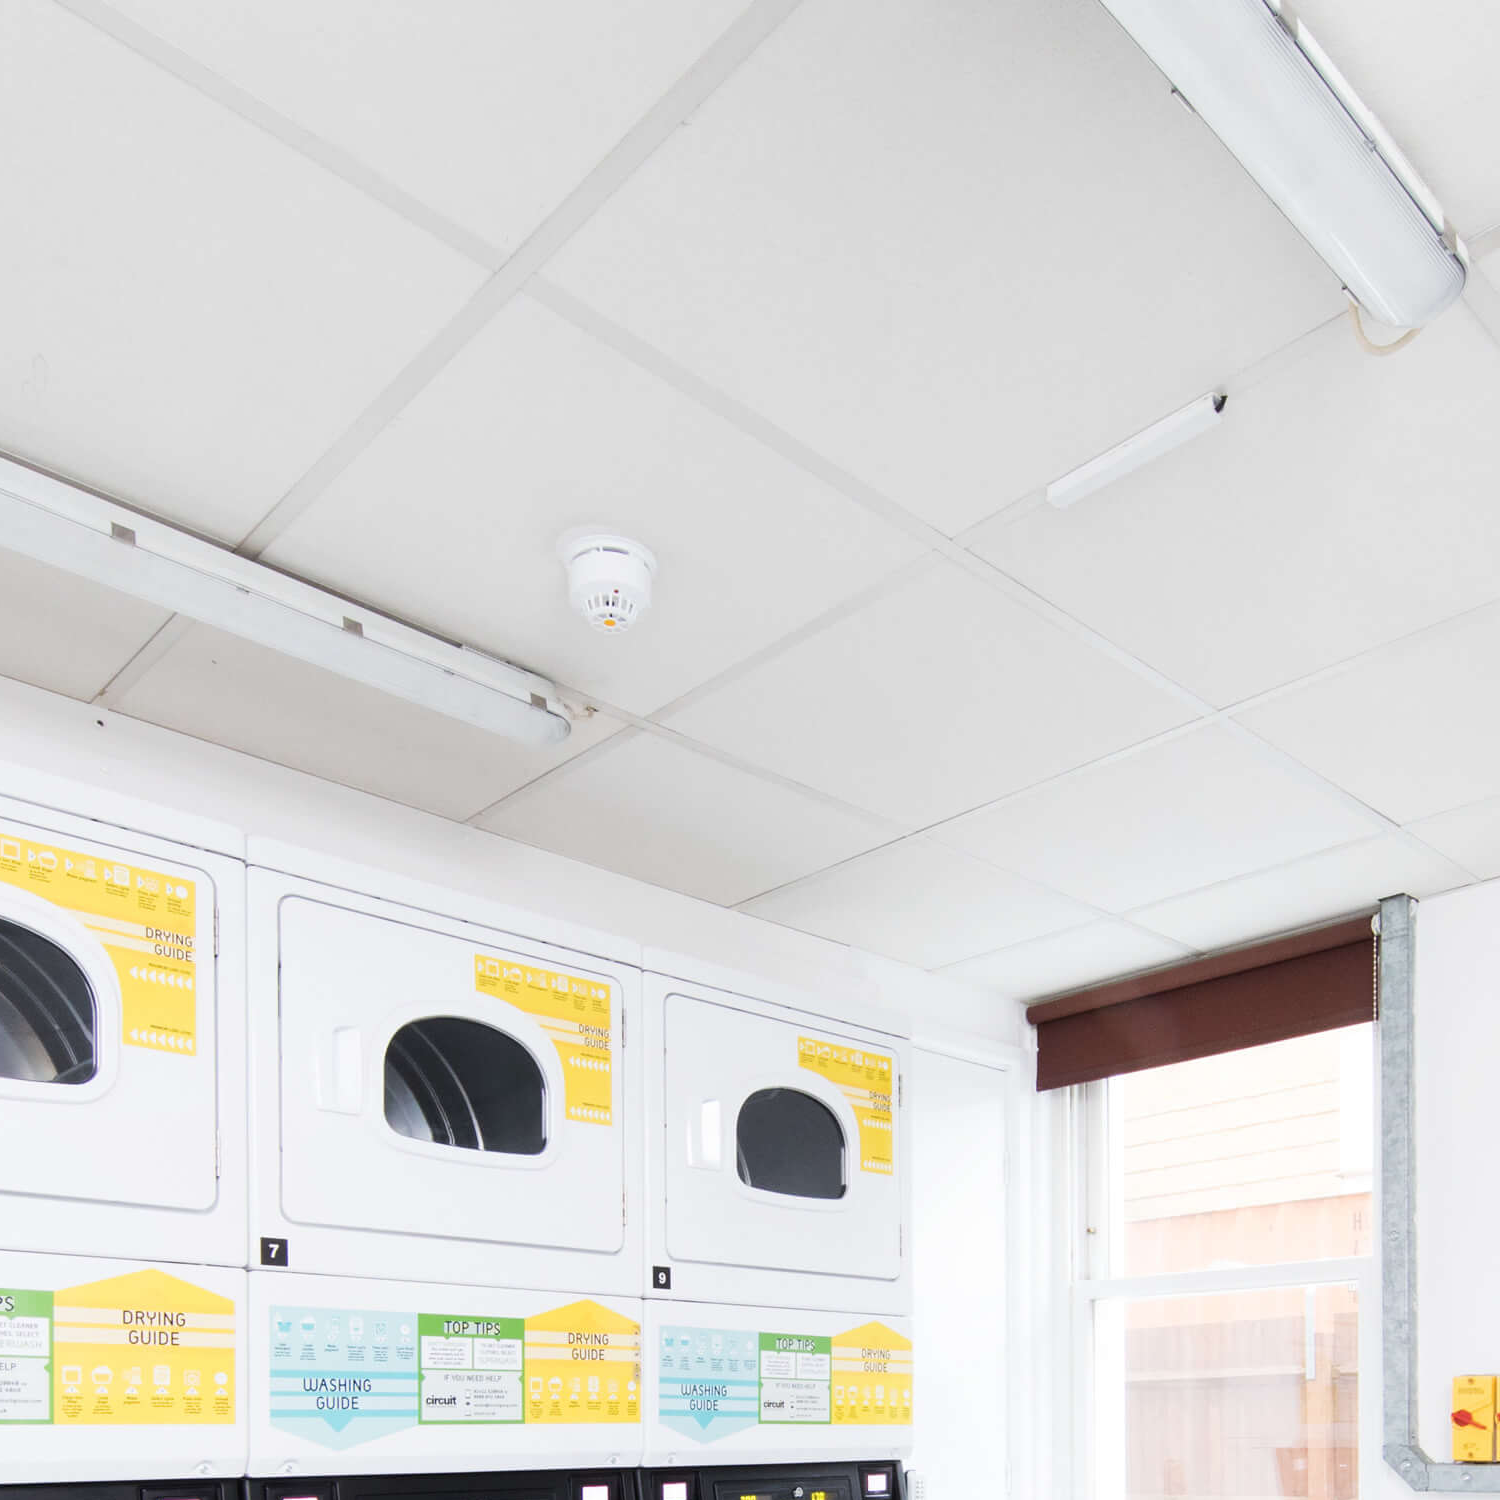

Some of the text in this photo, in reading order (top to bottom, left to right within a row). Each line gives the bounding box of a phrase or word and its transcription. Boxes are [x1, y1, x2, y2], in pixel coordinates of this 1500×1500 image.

[146, 926, 192, 947] DRYING
[154, 944, 192, 962] GUIDE
[579, 1024, 609, 1038] DRYING
[584, 1037, 608, 1050] GUIDE
[268, 1244, 279, 1258] 7
[658, 1272, 666, 1284] 9
[123, 1311, 186, 1326] DRYING
[446, 1321, 500, 1335] TOP TIPS
[129, 1330, 180, 1345] GUIDE
[568, 1333, 609, 1345] DRYING
[776, 1338, 815, 1350] TOP TIPS
[572, 1348, 604, 1361] GUIDE
[861, 1348, 891, 1360] DRYING
[864, 1362, 887, 1372] GUIDE
[303, 1378, 372, 1392] WASHING
[681, 1384, 727, 1397] WASHING
[316, 1396, 359, 1410] GUIDE
[426, 1396, 456, 1405] circuit
[690, 1399, 718, 1411] GUIDE
[764, 1399, 784, 1408] circuit
